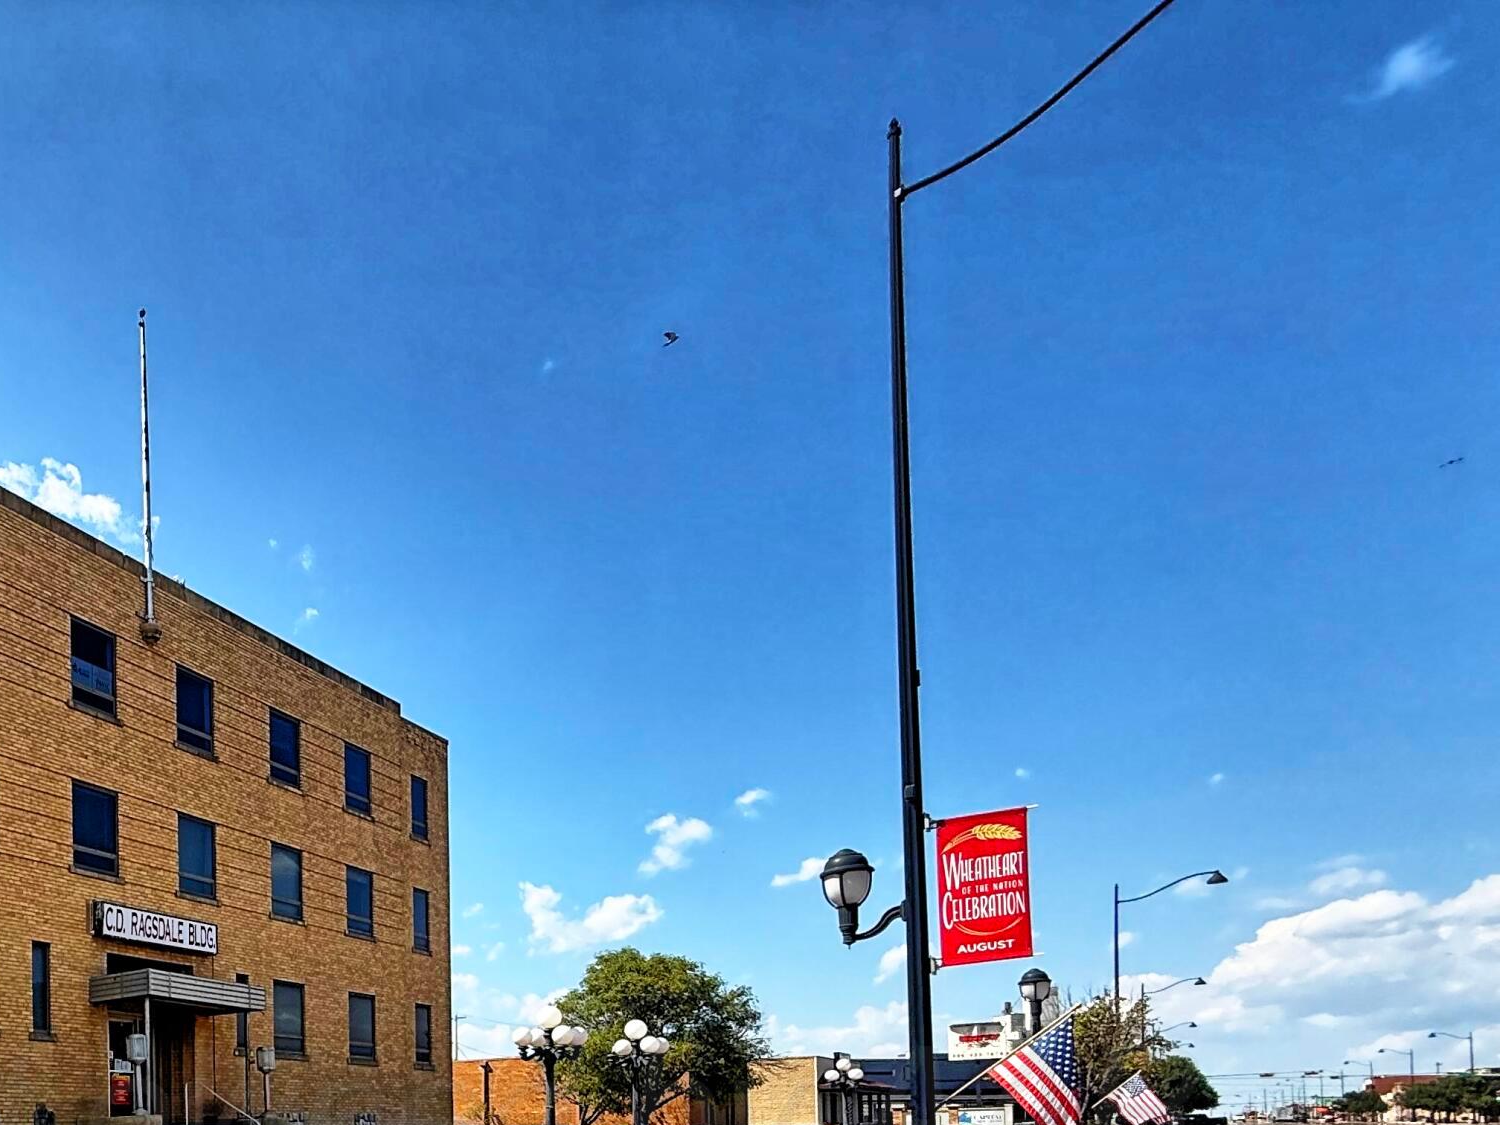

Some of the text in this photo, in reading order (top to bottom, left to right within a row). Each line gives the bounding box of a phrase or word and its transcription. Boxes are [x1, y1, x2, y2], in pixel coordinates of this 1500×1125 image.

[942, 851, 1025, 891] WHEATHEART
[961, 879, 1024, 895] OF THE NATION
[106, 907, 216, 949] C.D. RAGSDALE BLDG.
[942, 890, 1026, 930] CELEBRATION
[957, 939, 1015, 954] AUGUST
